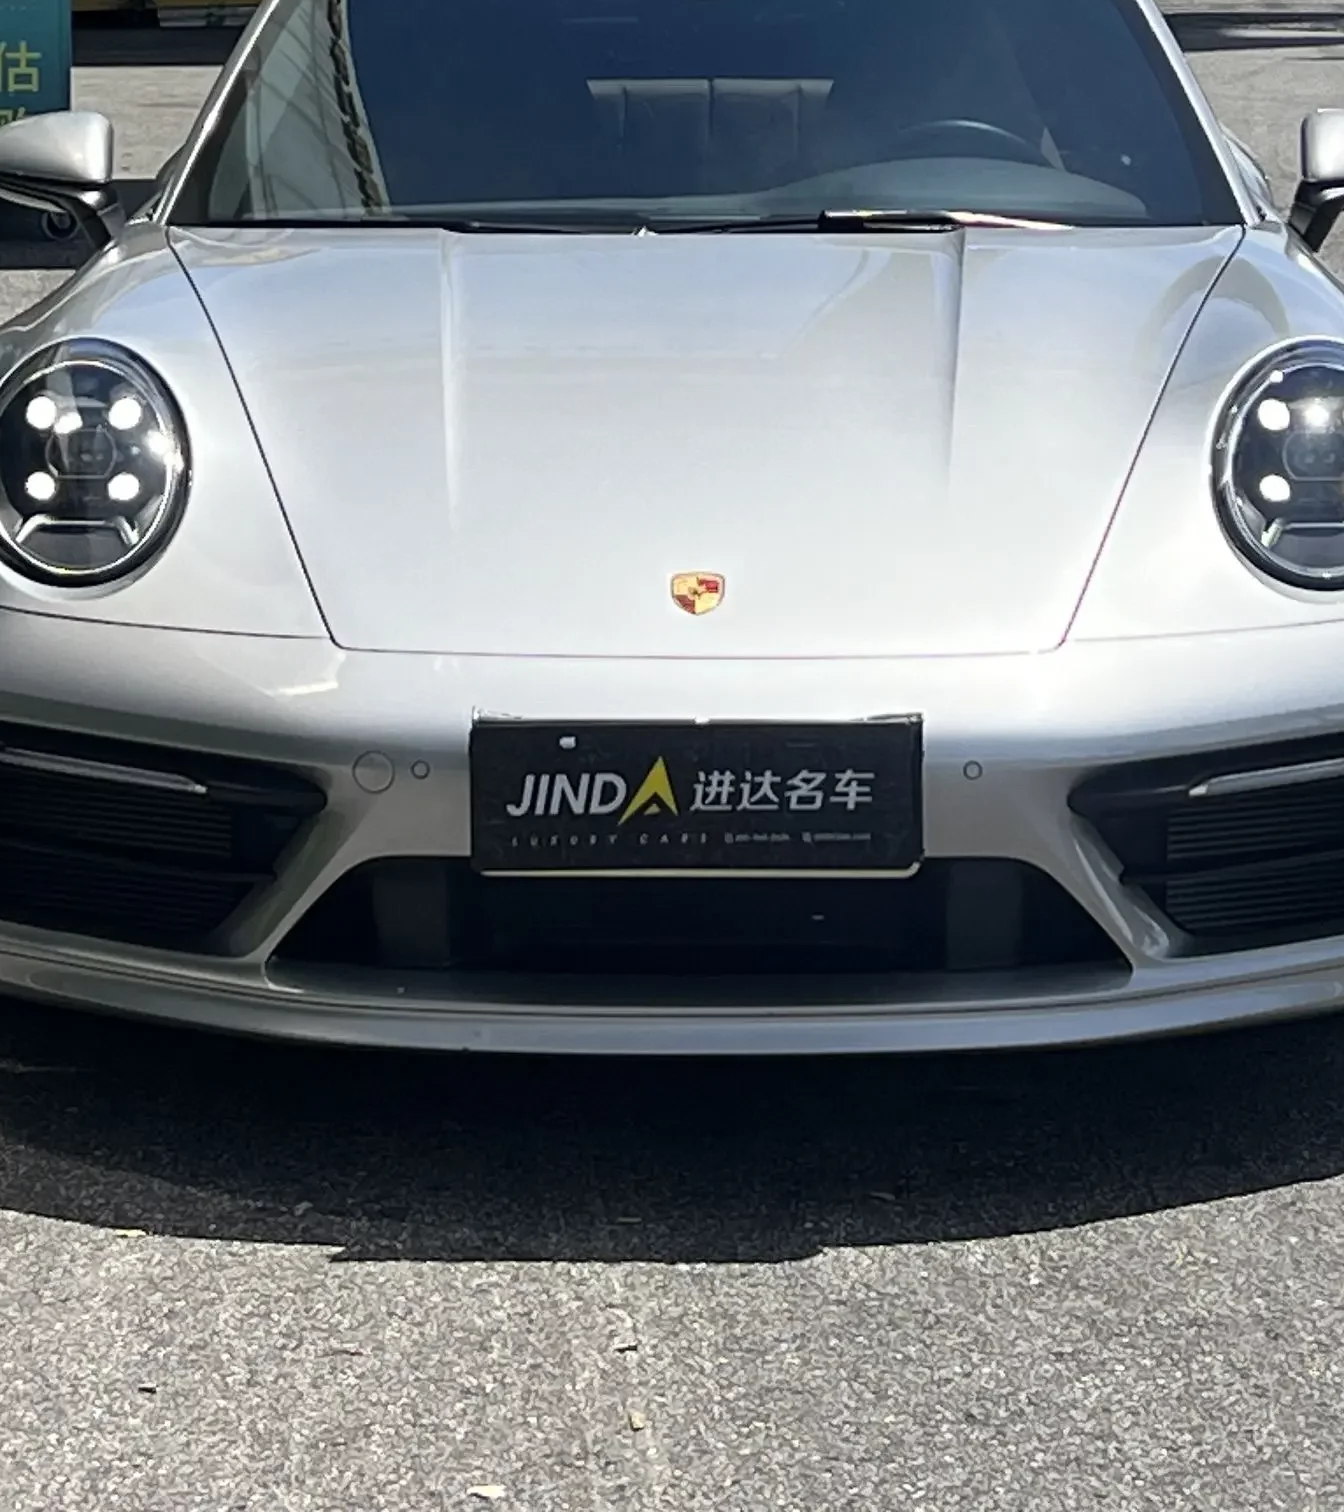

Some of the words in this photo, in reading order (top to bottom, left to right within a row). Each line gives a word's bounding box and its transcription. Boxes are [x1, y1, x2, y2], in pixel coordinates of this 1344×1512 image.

[506, 756, 679, 826] JINDA
[689, 769, 875, 812] 进达名车
